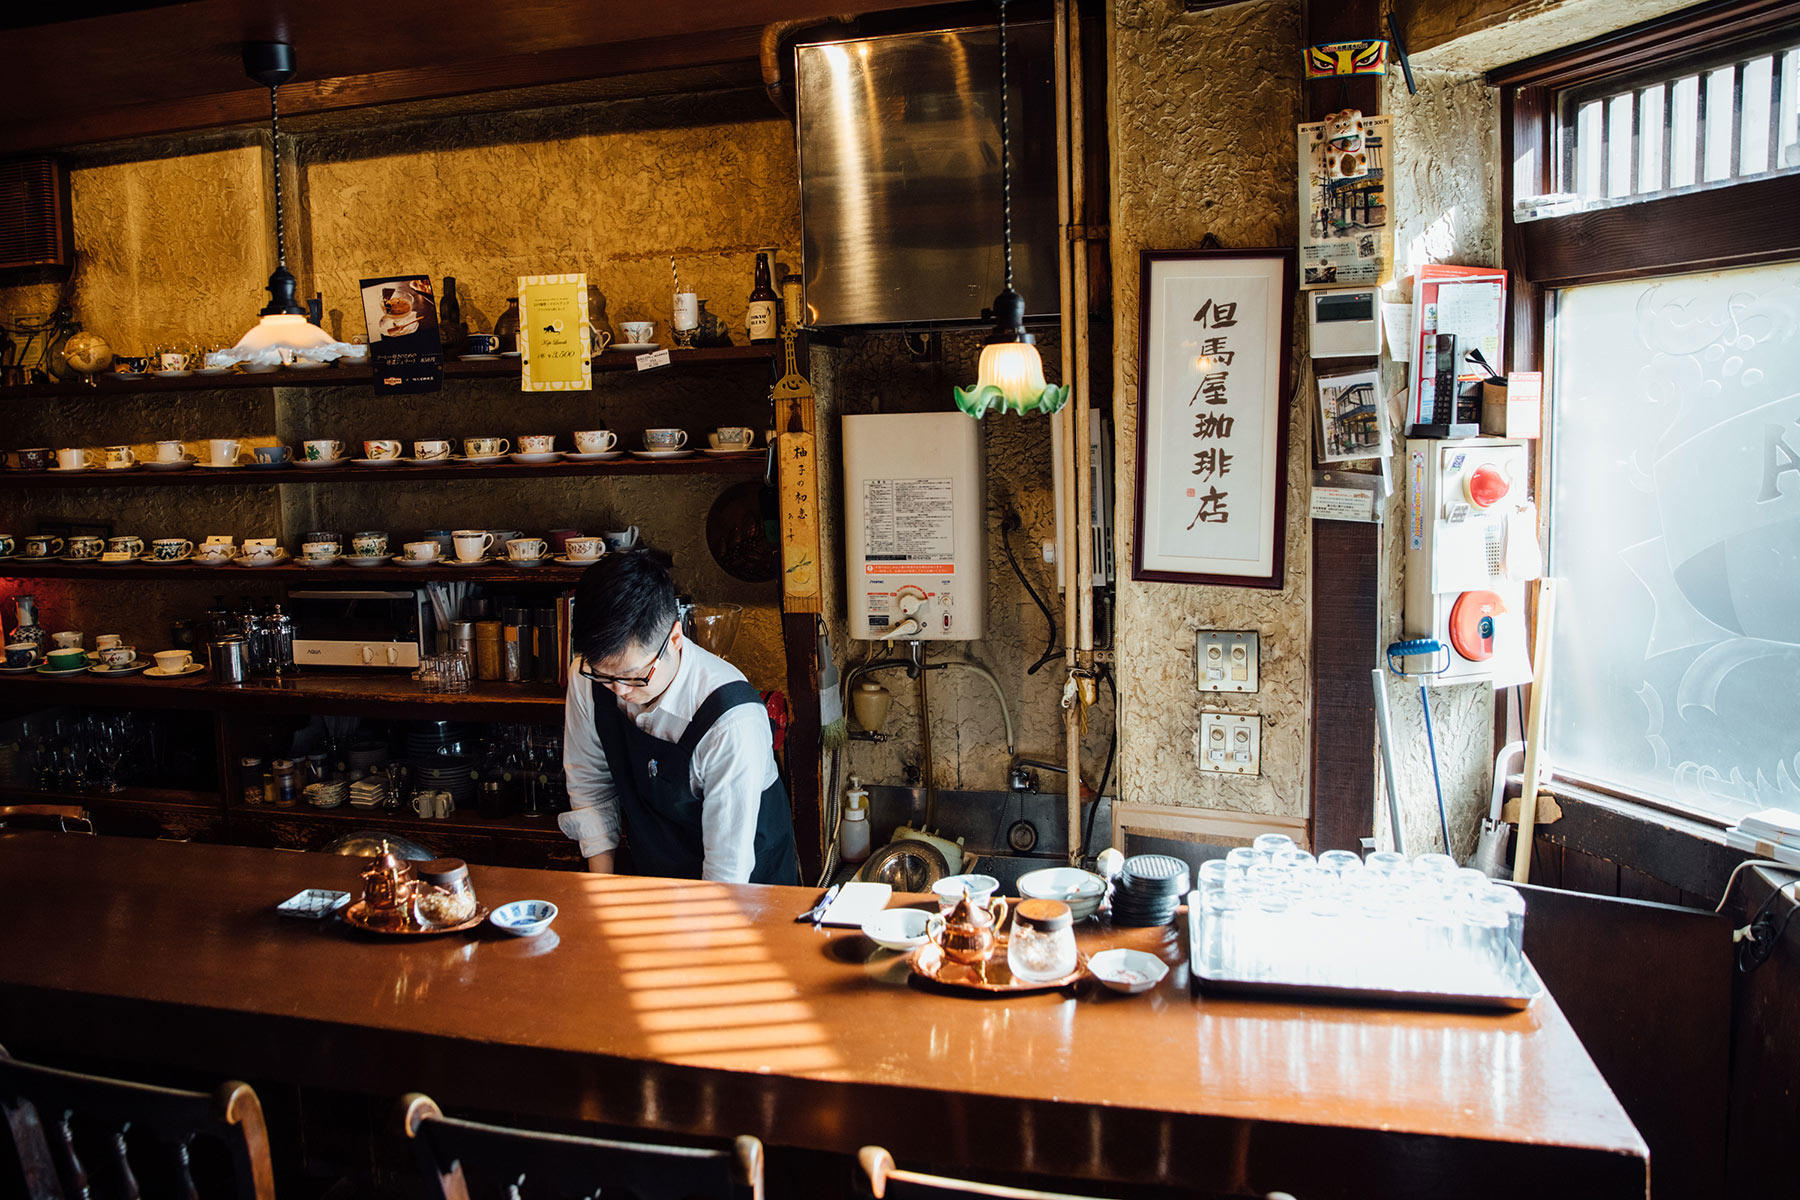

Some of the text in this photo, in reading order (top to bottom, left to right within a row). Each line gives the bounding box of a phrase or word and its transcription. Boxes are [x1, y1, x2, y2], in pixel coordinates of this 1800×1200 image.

[1186, 297, 1238, 531] 但馬屋珈琲店
